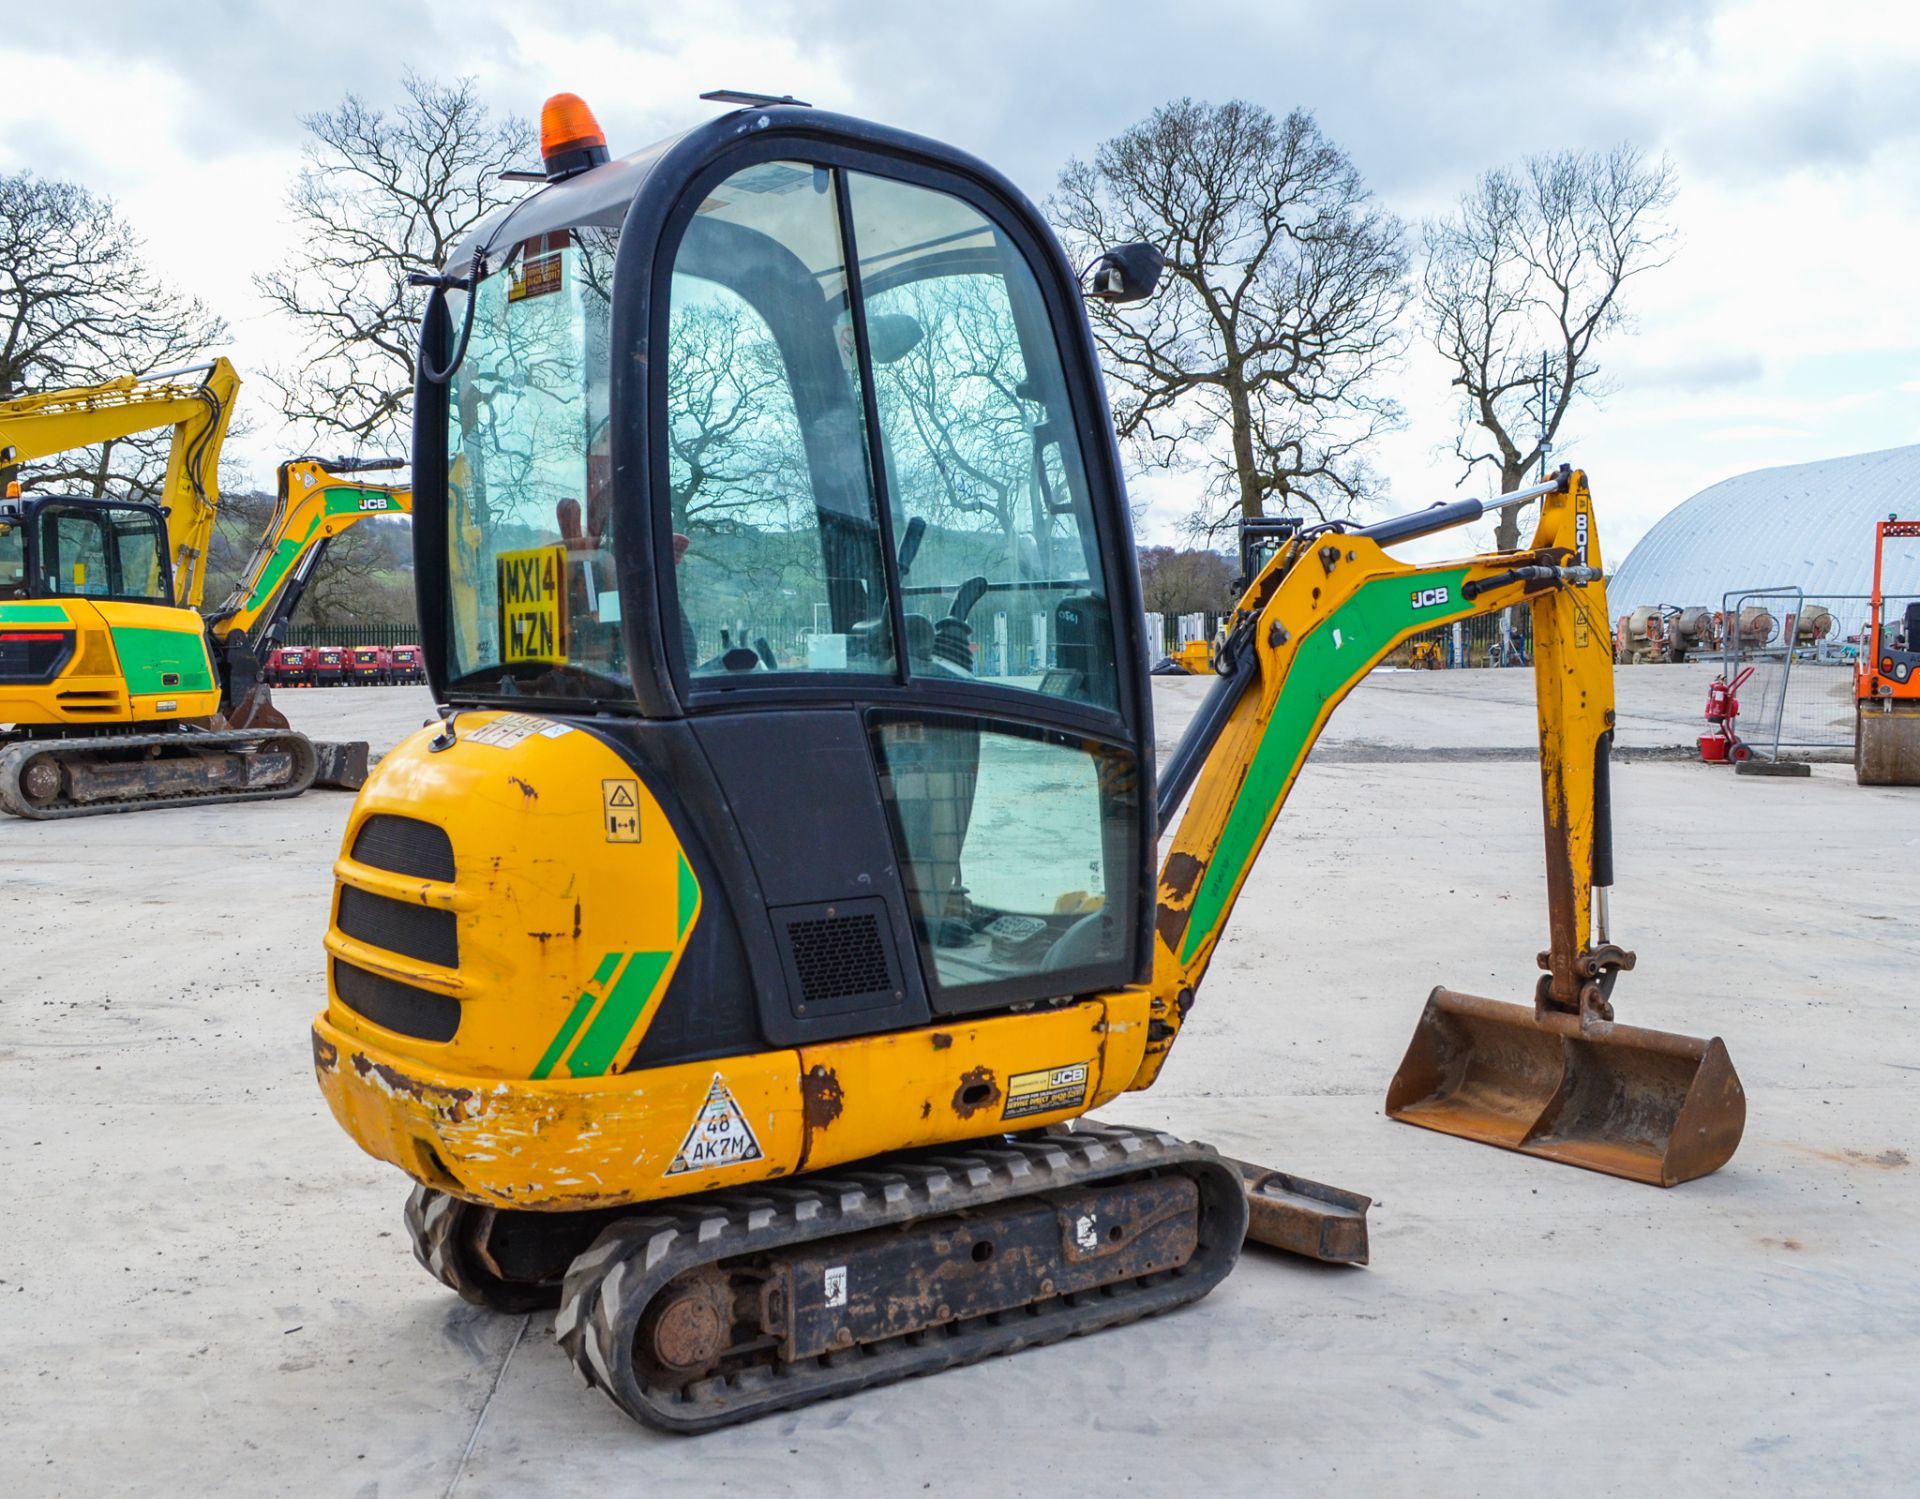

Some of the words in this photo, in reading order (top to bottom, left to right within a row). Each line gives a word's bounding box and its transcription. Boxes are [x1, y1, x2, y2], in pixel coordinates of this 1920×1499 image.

[359, 499, 388, 510] JCB
[1576, 514, 1588, 574] 801
[506, 555, 556, 604] MX14
[1412, 587, 1449, 609] JCB
[510, 611, 553, 658] MZN
[1052, 1069, 1084, 1085] JCB
[707, 1114, 730, 1134] 48
[693, 1135, 744, 1161] AK7M
